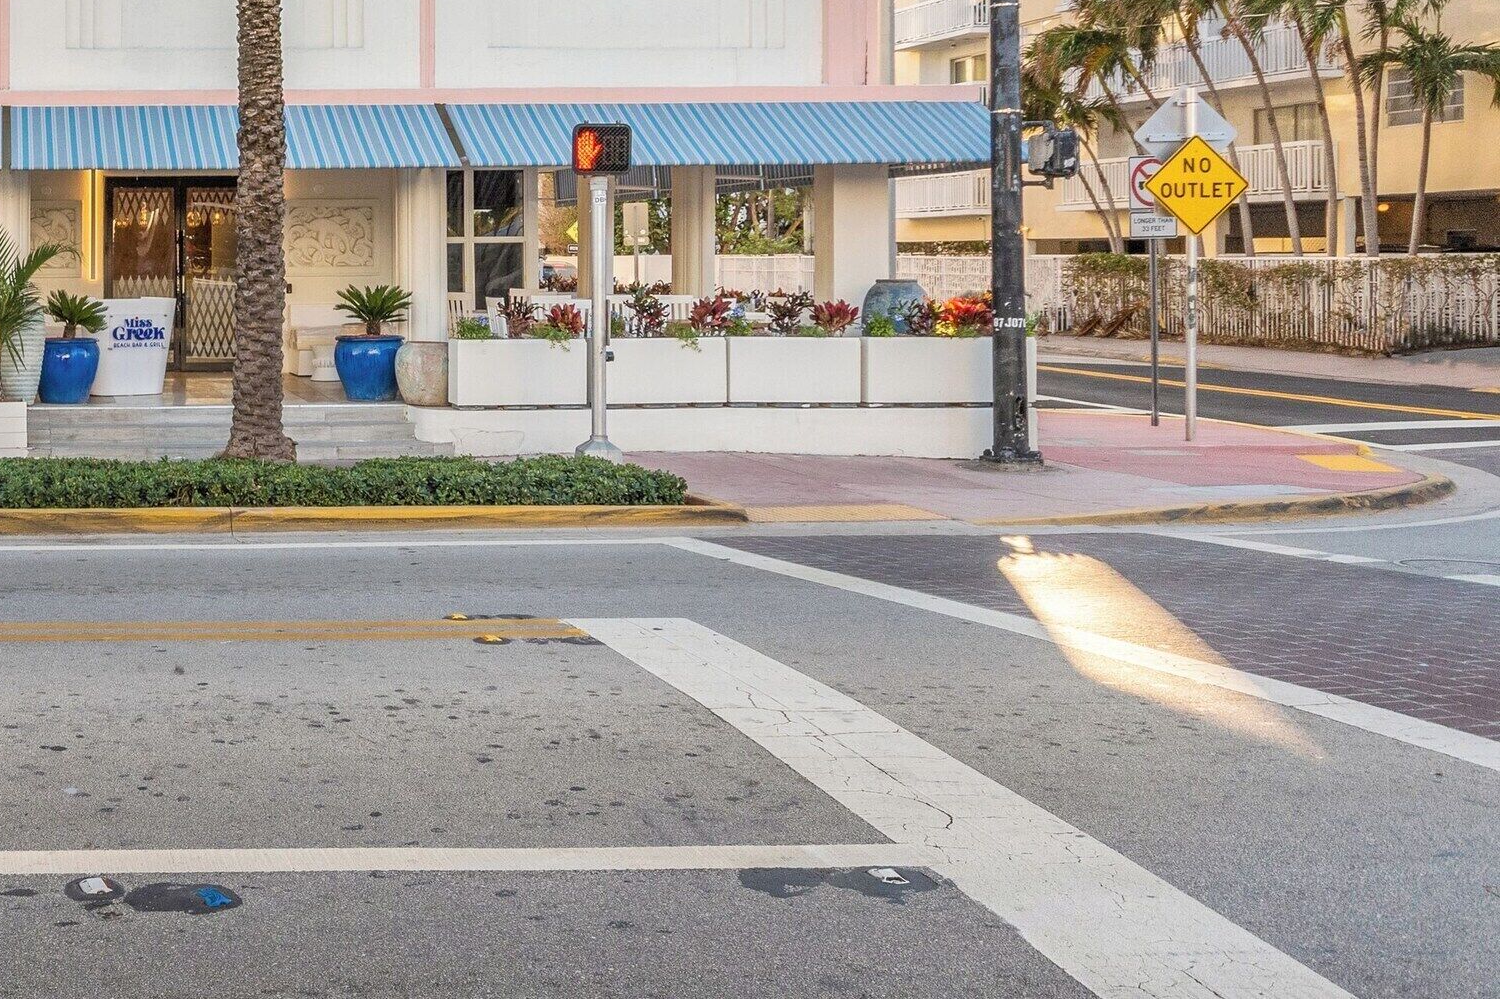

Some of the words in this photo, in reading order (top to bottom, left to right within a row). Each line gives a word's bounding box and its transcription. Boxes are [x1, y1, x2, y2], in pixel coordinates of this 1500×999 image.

[1183, 157, 1211, 173] NO
[1160, 183, 1235, 198] OUTLET
[124, 317, 153, 327] Miss
[112, 326, 166, 341] Greek
